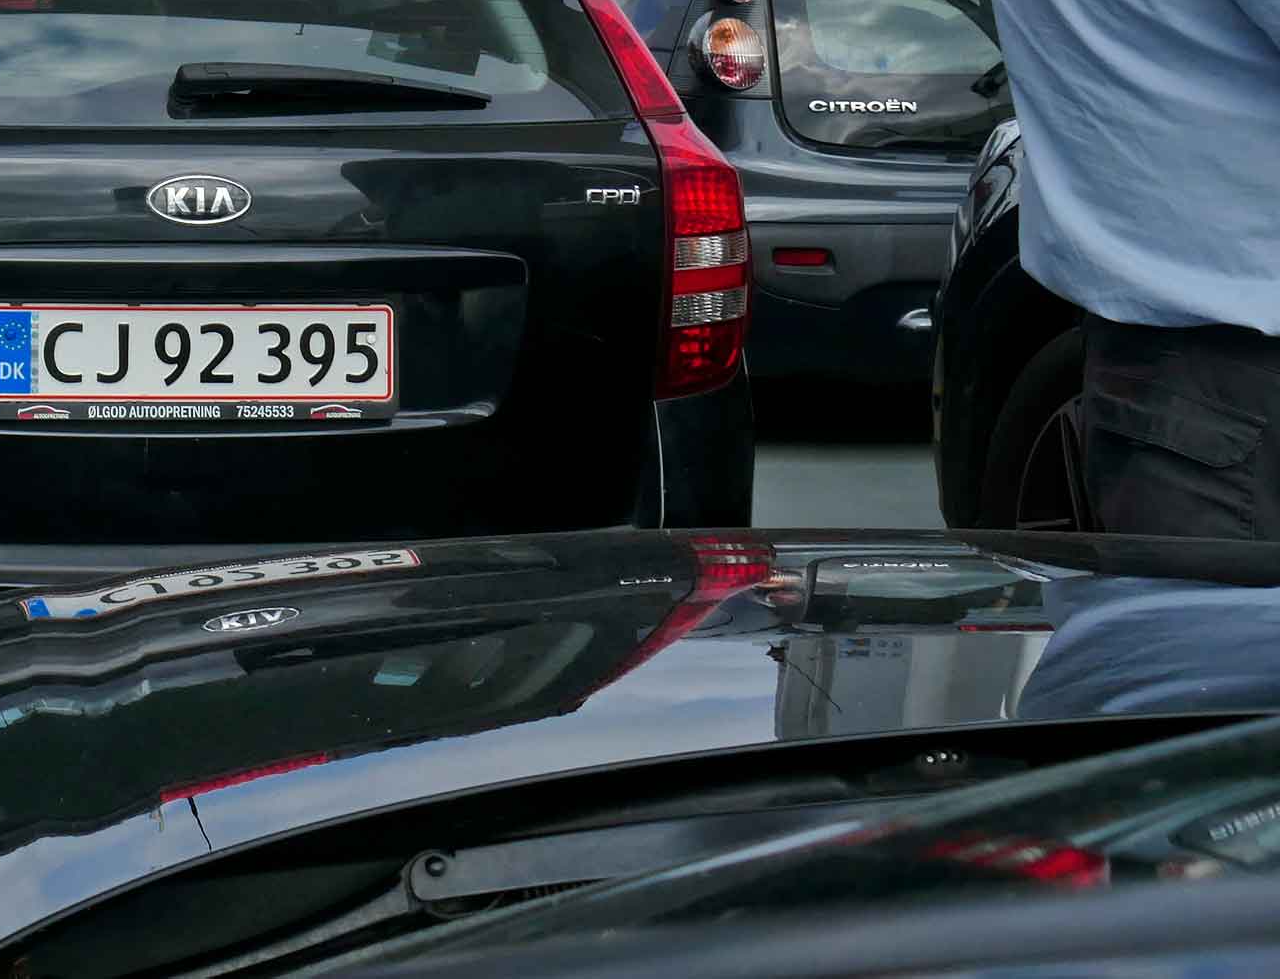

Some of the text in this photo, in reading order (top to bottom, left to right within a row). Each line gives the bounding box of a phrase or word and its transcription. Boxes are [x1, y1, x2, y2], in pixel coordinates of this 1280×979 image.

[809, 98, 918, 113] CITROËN
[165, 186, 237, 214] KIA
[42, 322, 380, 387] CJ 92 395
[0, 361, 26, 381] DK
[88, 405, 295, 419] ØLGOD AUTOOPRETNING 75245533
